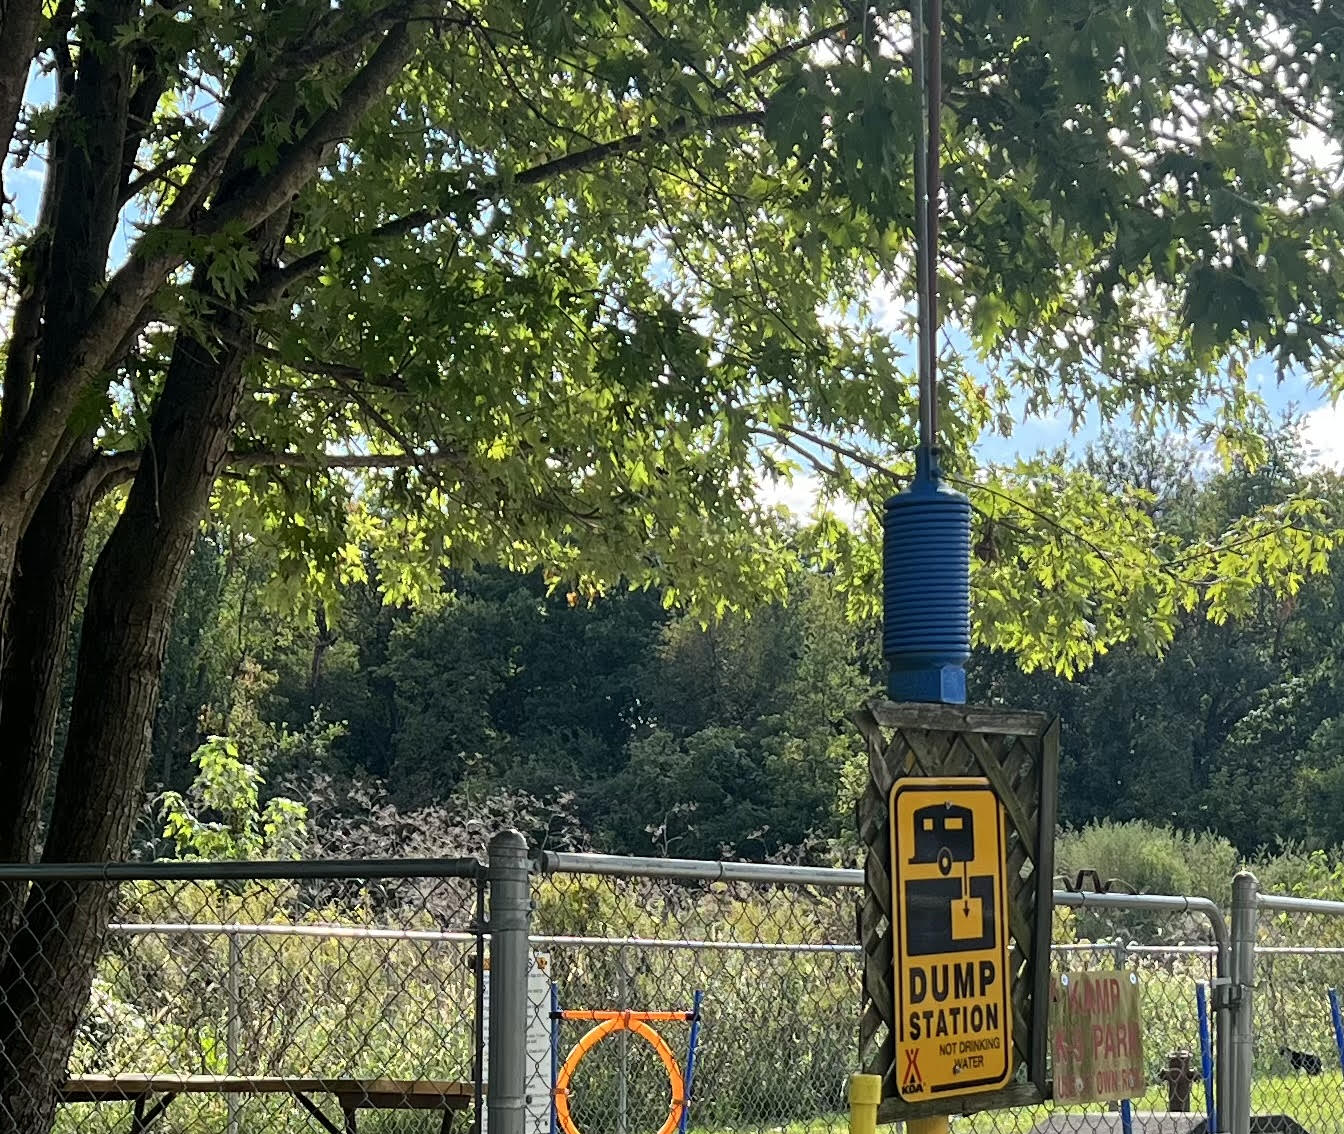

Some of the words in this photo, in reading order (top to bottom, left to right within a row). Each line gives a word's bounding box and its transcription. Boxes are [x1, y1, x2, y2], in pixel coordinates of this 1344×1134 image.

[909, 960, 995, 1004] DUMP
[909, 1003, 998, 1040] STATION
[939, 1042, 957, 1056] NOT
[959, 1037, 1000, 1054] DRINKING
[954, 1055, 984, 1071] WATER
[901, 1083, 923, 1095] KOA
